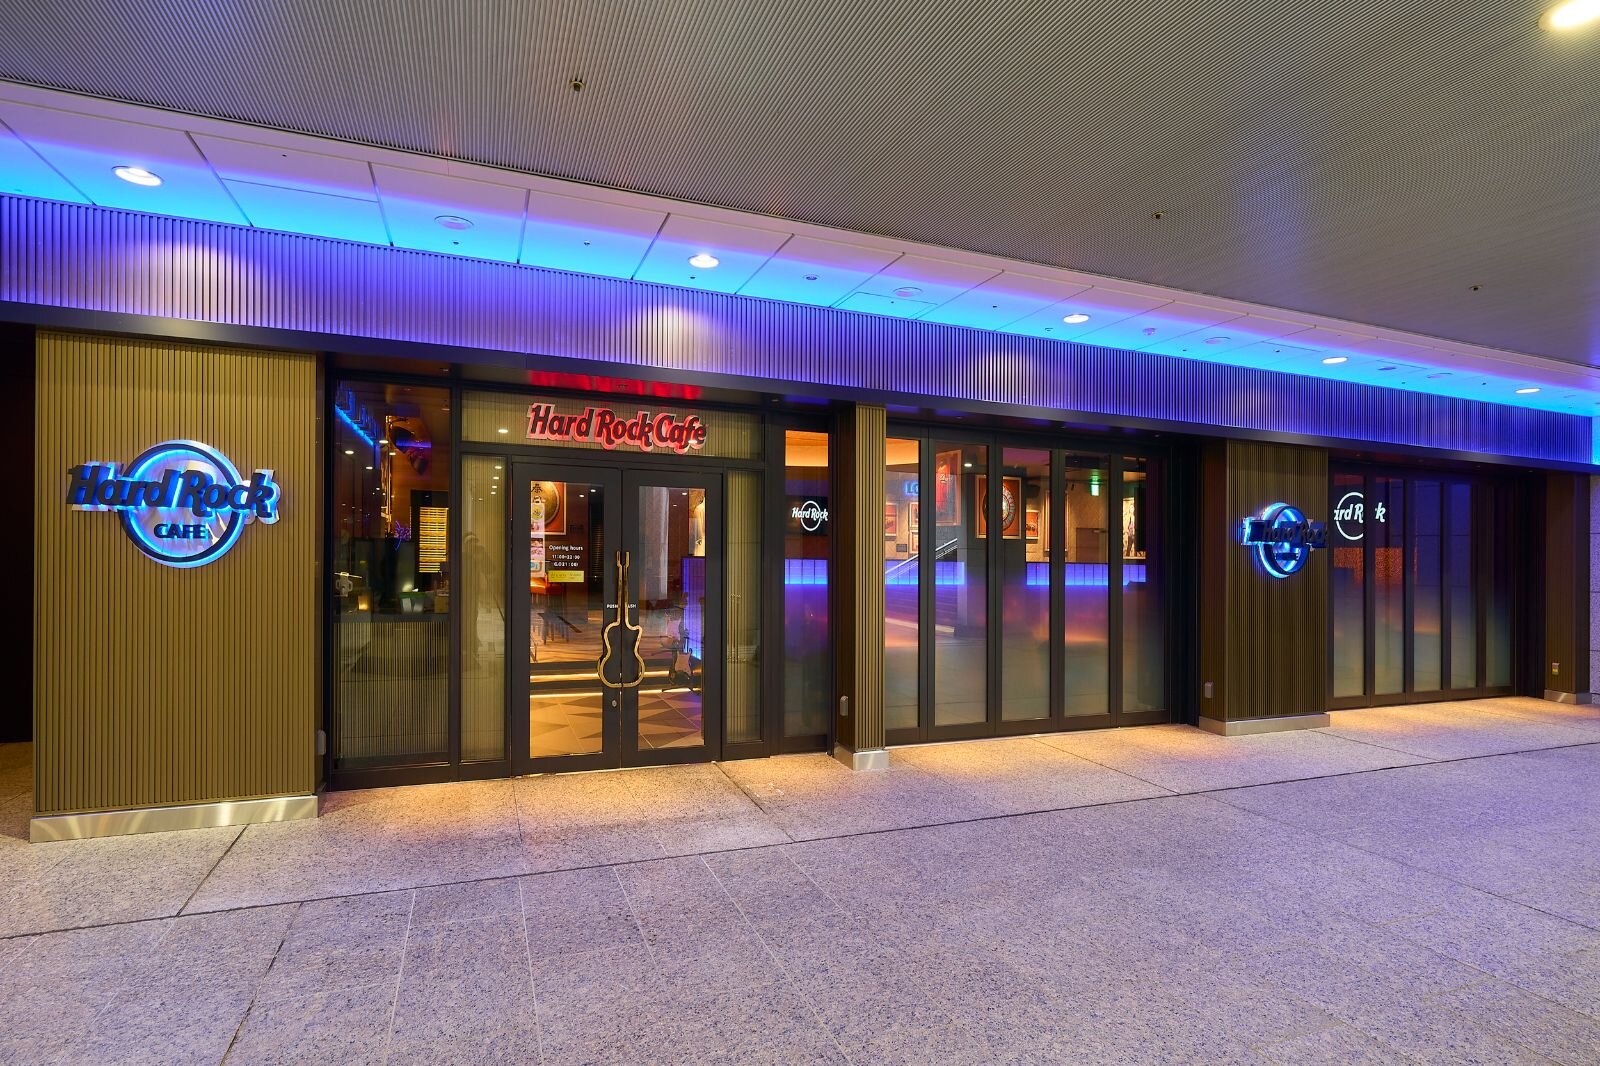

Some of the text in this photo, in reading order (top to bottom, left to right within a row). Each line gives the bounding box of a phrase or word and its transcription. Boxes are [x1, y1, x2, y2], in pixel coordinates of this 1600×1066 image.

[529, 404, 708, 451] Hard Rock Cafe
[66, 463, 277, 519] Hard Rock
[791, 507, 829, 521] Hard Rock
[153, 523, 207, 539] CAFE
